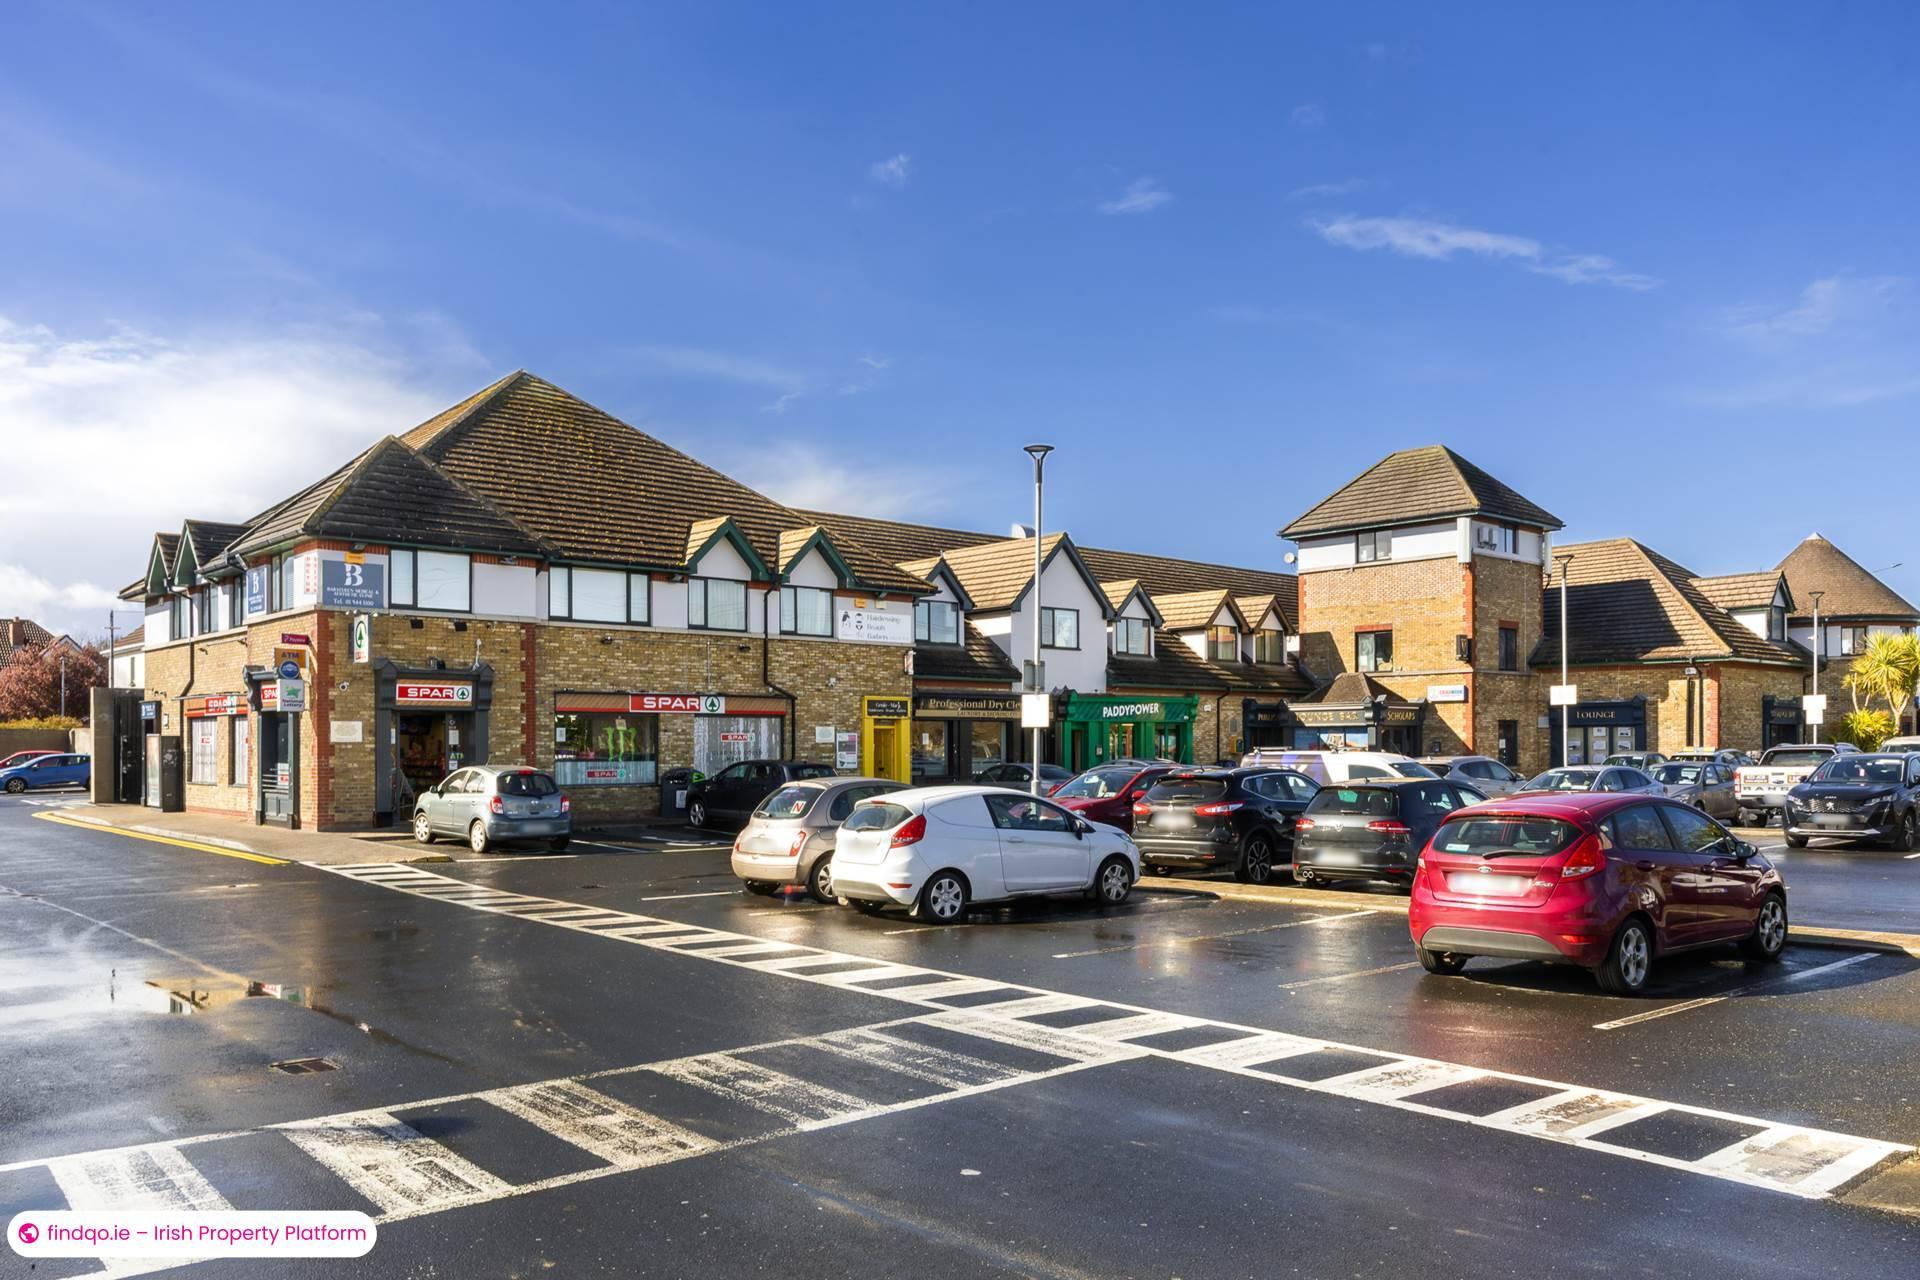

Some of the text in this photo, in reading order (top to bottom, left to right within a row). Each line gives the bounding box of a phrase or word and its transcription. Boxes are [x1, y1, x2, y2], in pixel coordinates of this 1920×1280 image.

[344, 563, 363, 586] B
[407, 688, 454, 698] SPAR
[643, 697, 700, 709] SPAR
[929, 699, 986, 709] Professional
[988, 701, 1004, 710] Dry
[1103, 703, 1159, 718] PADDYPOWER
[1296, 711, 1333, 721] LOUNGE
[792, 802, 804, 813] N
